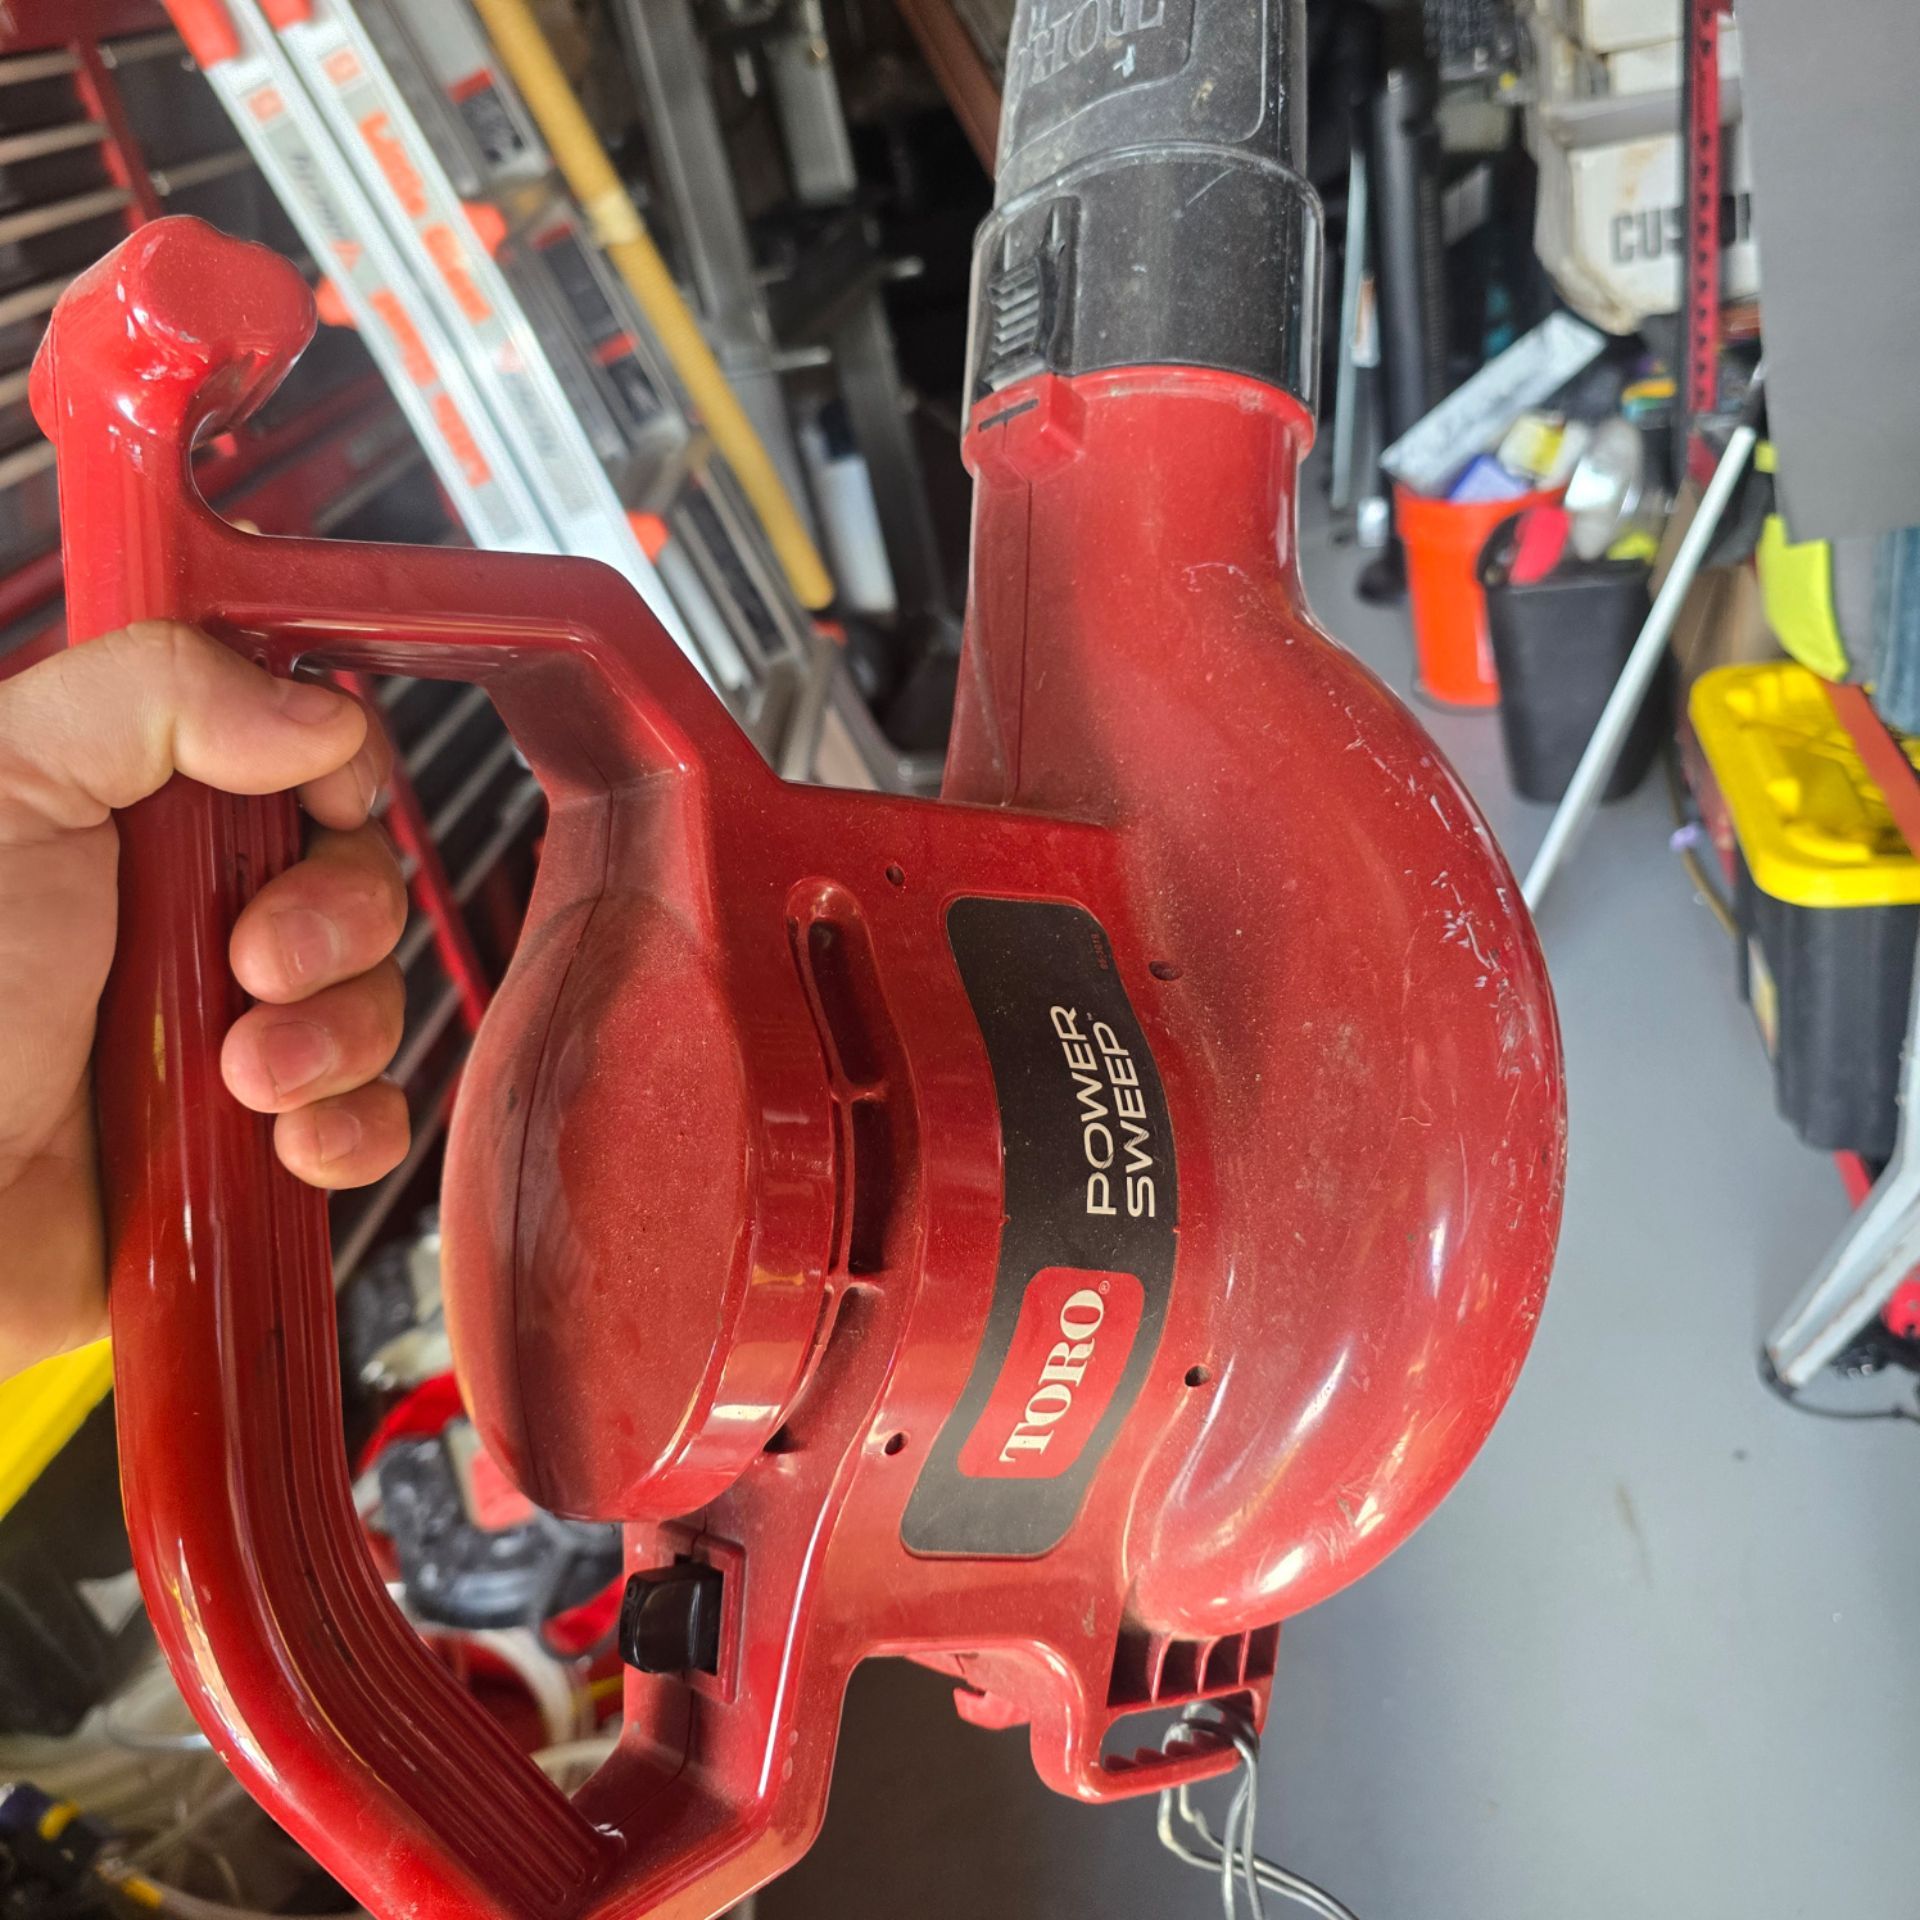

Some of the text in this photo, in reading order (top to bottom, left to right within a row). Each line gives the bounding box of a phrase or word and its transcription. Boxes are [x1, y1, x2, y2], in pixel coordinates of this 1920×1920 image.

[1050, 1005, 1117, 1216] POWER
[1092, 1021, 1156, 1218] SWEEP
[999, 1289, 1105, 1464] TORO
